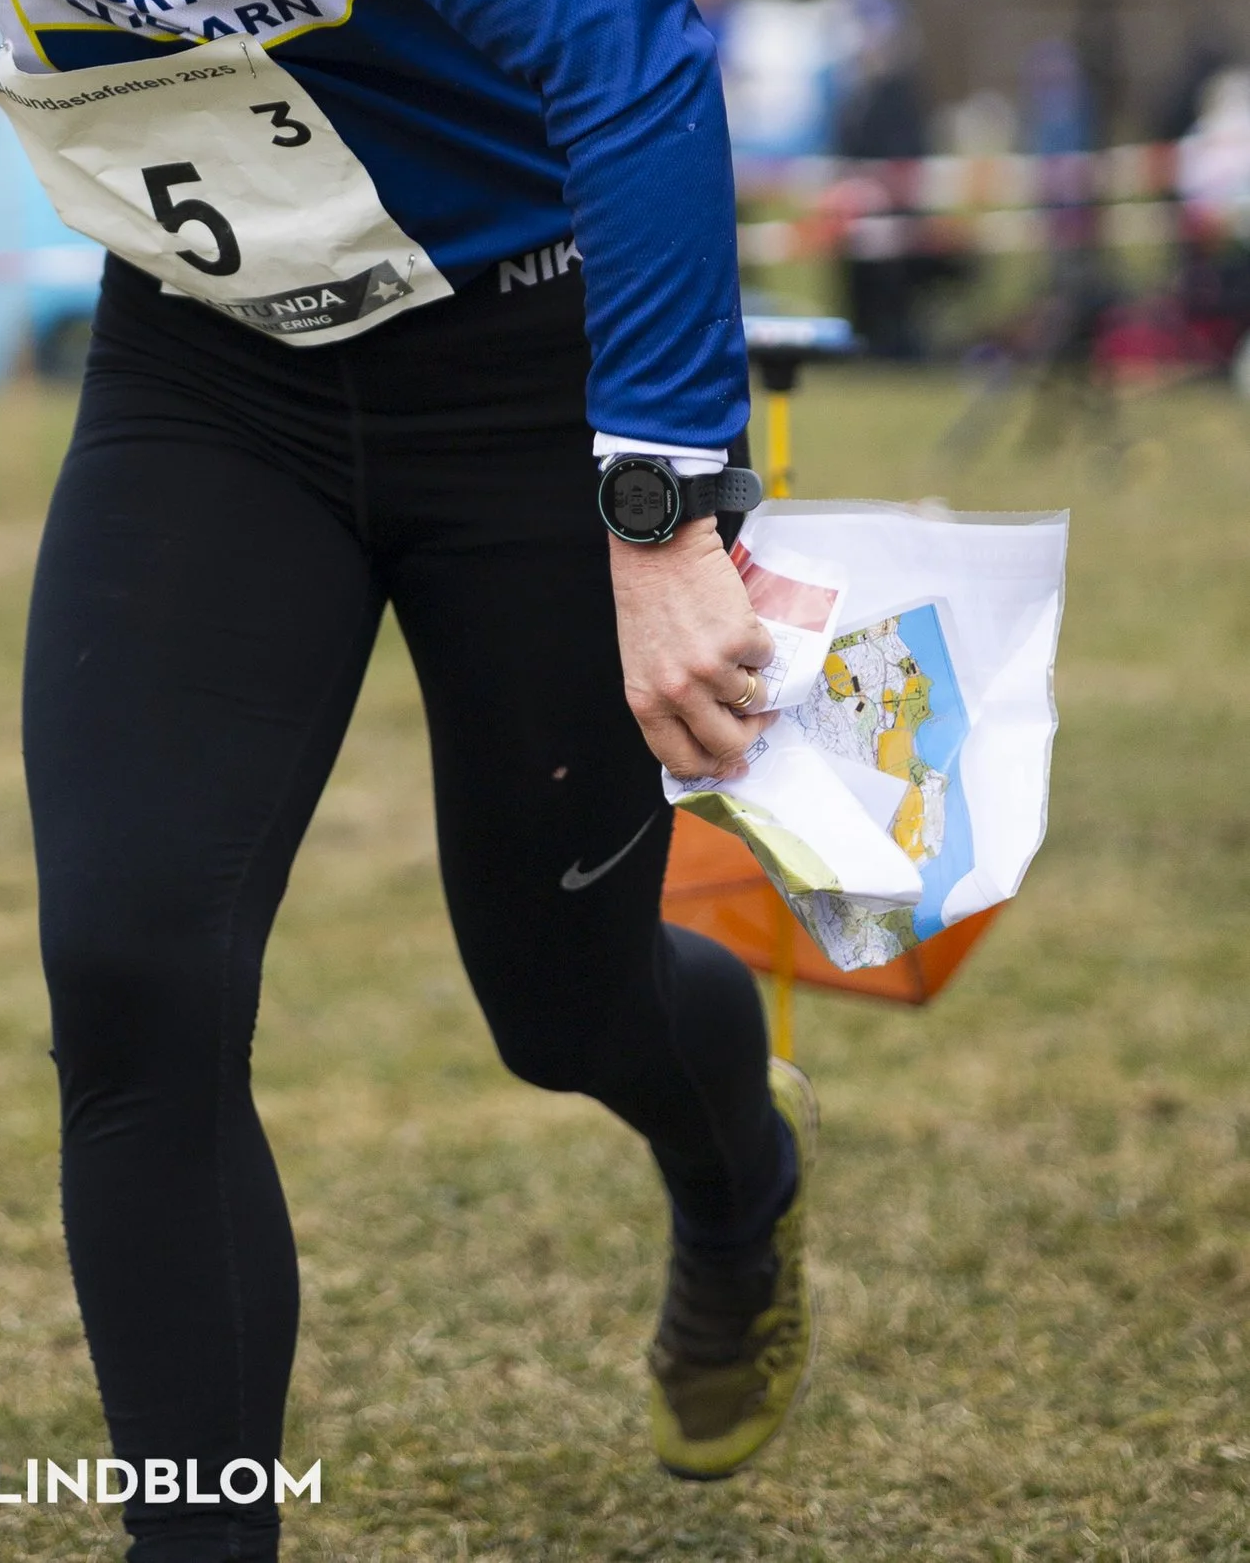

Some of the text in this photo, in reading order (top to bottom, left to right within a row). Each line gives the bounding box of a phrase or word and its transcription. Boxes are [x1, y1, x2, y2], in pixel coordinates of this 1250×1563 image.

[176, 64, 237, 84] 2025
[250, 100, 312, 148] 3
[141, 161, 242, 277] 5
[499, 238, 584, 294] NIK
